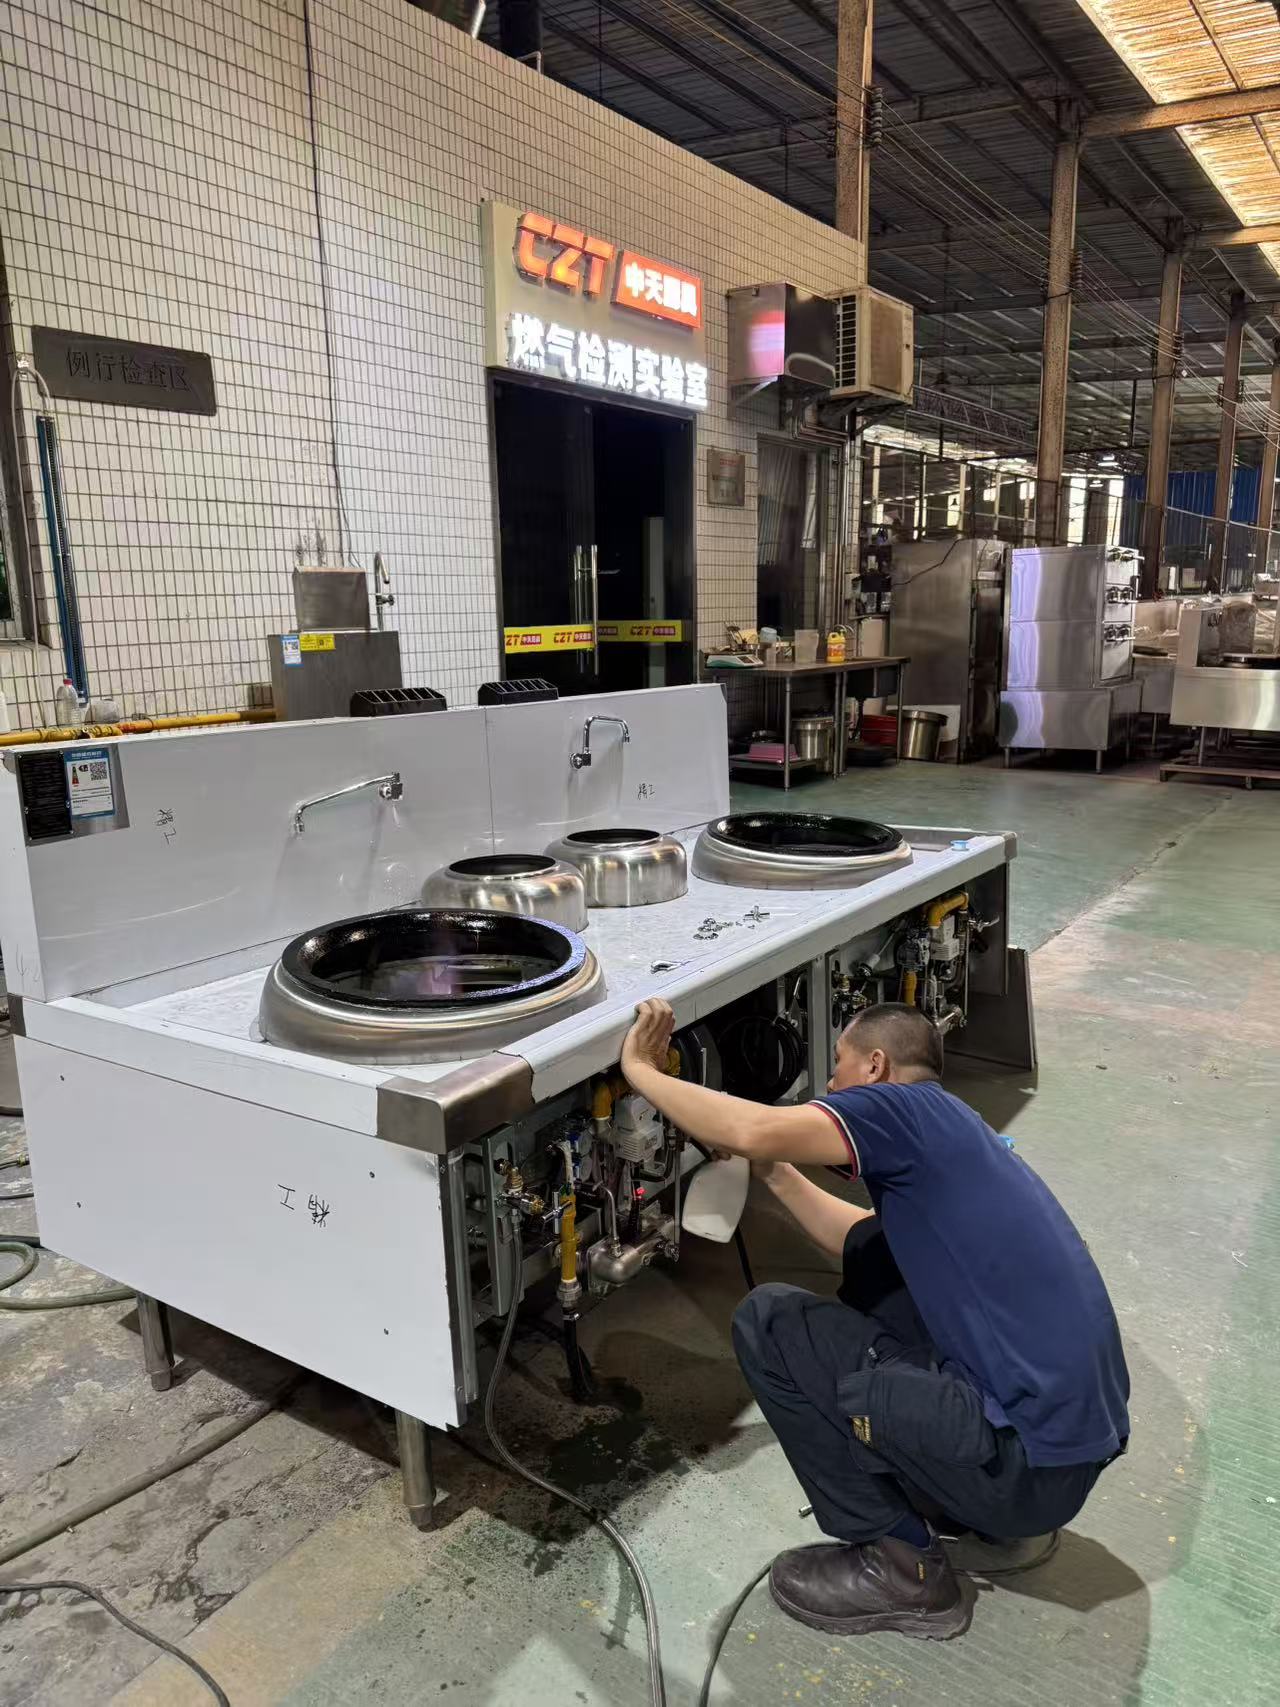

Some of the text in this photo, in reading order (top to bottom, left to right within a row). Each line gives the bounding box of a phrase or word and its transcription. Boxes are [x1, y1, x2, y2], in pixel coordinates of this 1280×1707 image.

[516, 211, 615, 296] CZT
[66, 349, 191, 392] 例行检查区
[510, 312, 708, 408] 燃气检测实验室
[553, 632, 573, 644] CZT
